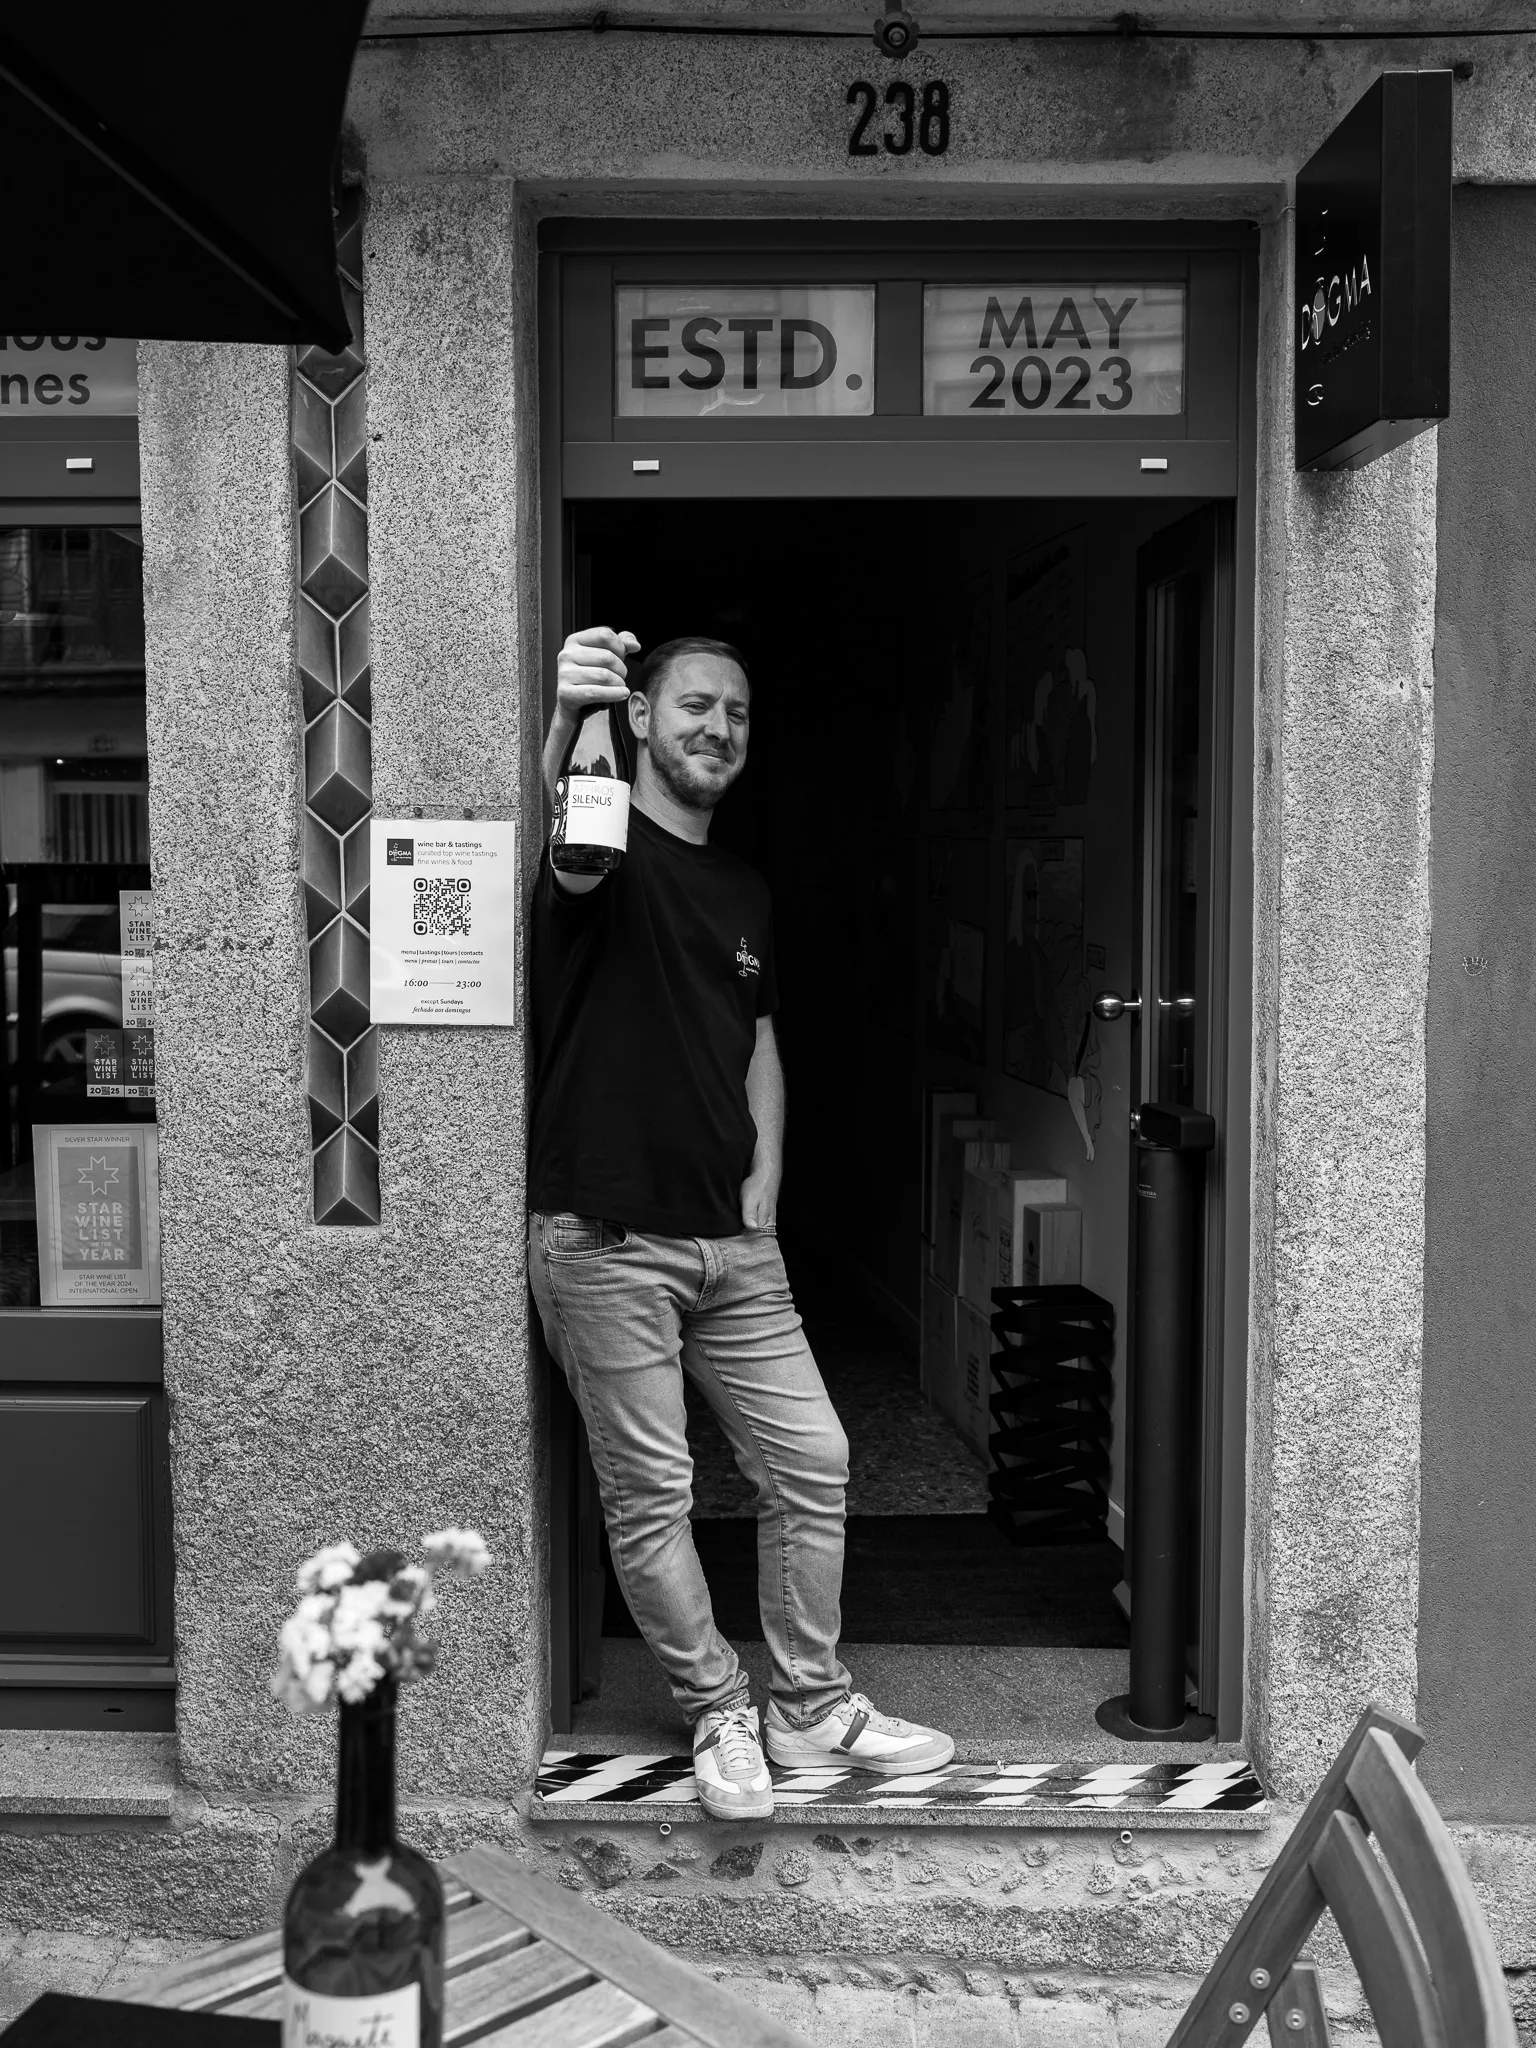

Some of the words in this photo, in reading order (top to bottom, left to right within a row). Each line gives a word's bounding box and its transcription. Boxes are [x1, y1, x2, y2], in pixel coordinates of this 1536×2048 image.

[847, 80, 950, 156] 238
[979, 296, 1139, 349] MAY
[631, 317, 863, 390] ESTD.
[968, 355, 1133, 411] 2023
[572, 794, 612, 806] SILENUS
[455, 841, 482, 850] tastings
[472, 850, 498, 858] tastings
[457, 858, 473, 866] food
[128, 920, 151, 928] STAR
[127, 927, 151, 935] WINE
[129, 934, 151, 942] LIST
[404, 978, 429, 987] 16:00
[455, 980, 482, 990] 23:00
[95, 1058, 117, 1066] STAR
[131, 1058, 154, 1066] STAR
[77, 1202, 122, 1214] STAR
[74, 1215, 122, 1227] WINE
[78, 1228, 123, 1241] LIST
[79, 1248, 125, 1261] YEAR
